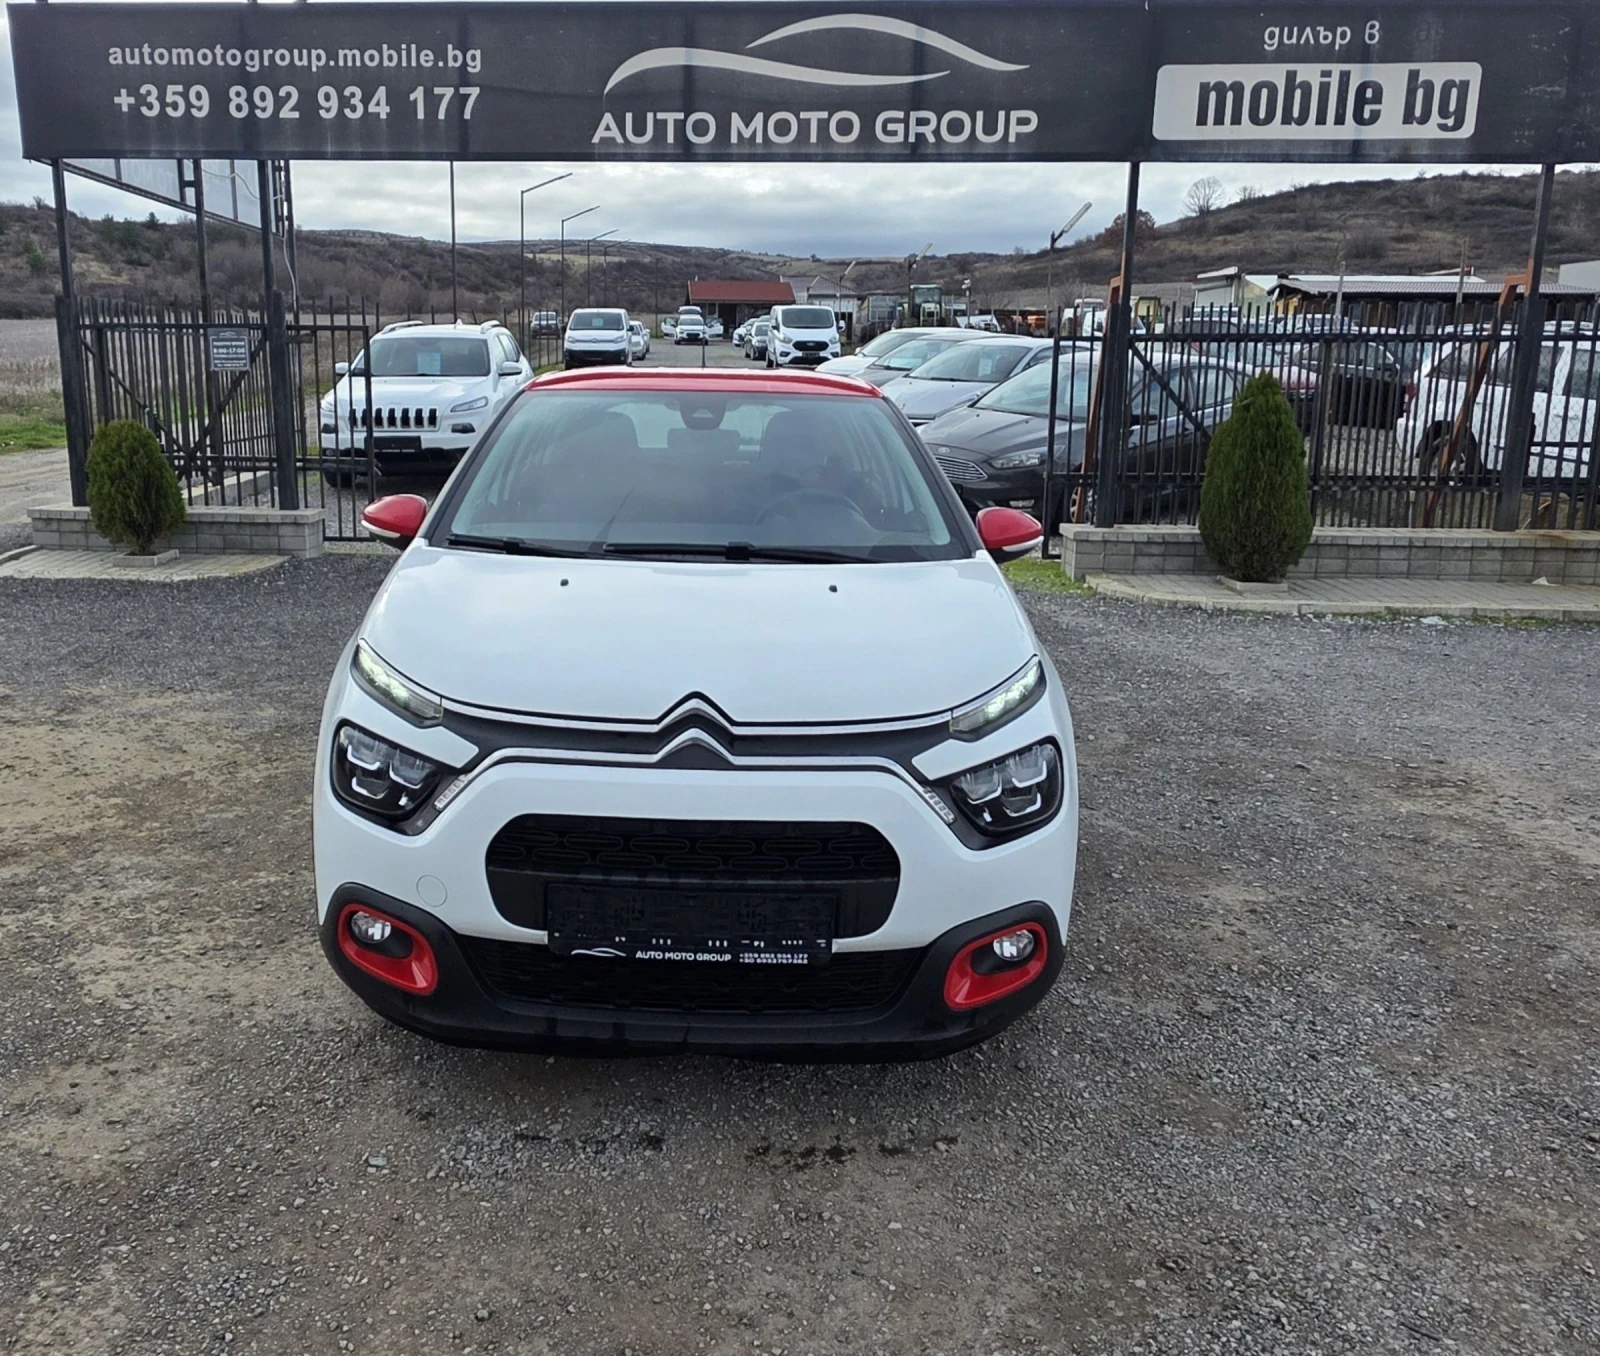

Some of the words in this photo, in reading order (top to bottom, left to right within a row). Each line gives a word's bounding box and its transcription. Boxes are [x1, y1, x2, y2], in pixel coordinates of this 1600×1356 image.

[1263, 25, 1352, 51] дилър
[1364, 20, 1381, 45] в
[108, 42, 482, 73] automotogroup.mobile.bg
[113, 83, 210, 118] +359
[228, 85, 300, 119] 892
[317, 85, 391, 120] 934
[409, 85, 481, 120] 177
[1195, 69, 1384, 127] mobile
[1401, 68, 1471, 133] bg
[592, 111, 716, 145] AUTO
[731, 110, 861, 144] MOTO
[875, 109, 1039, 144] GROUP
[635, 950, 663, 960] AUTO
[664, 951, 695, 961] MOTO
[696, 952, 732, 962] GROUP
